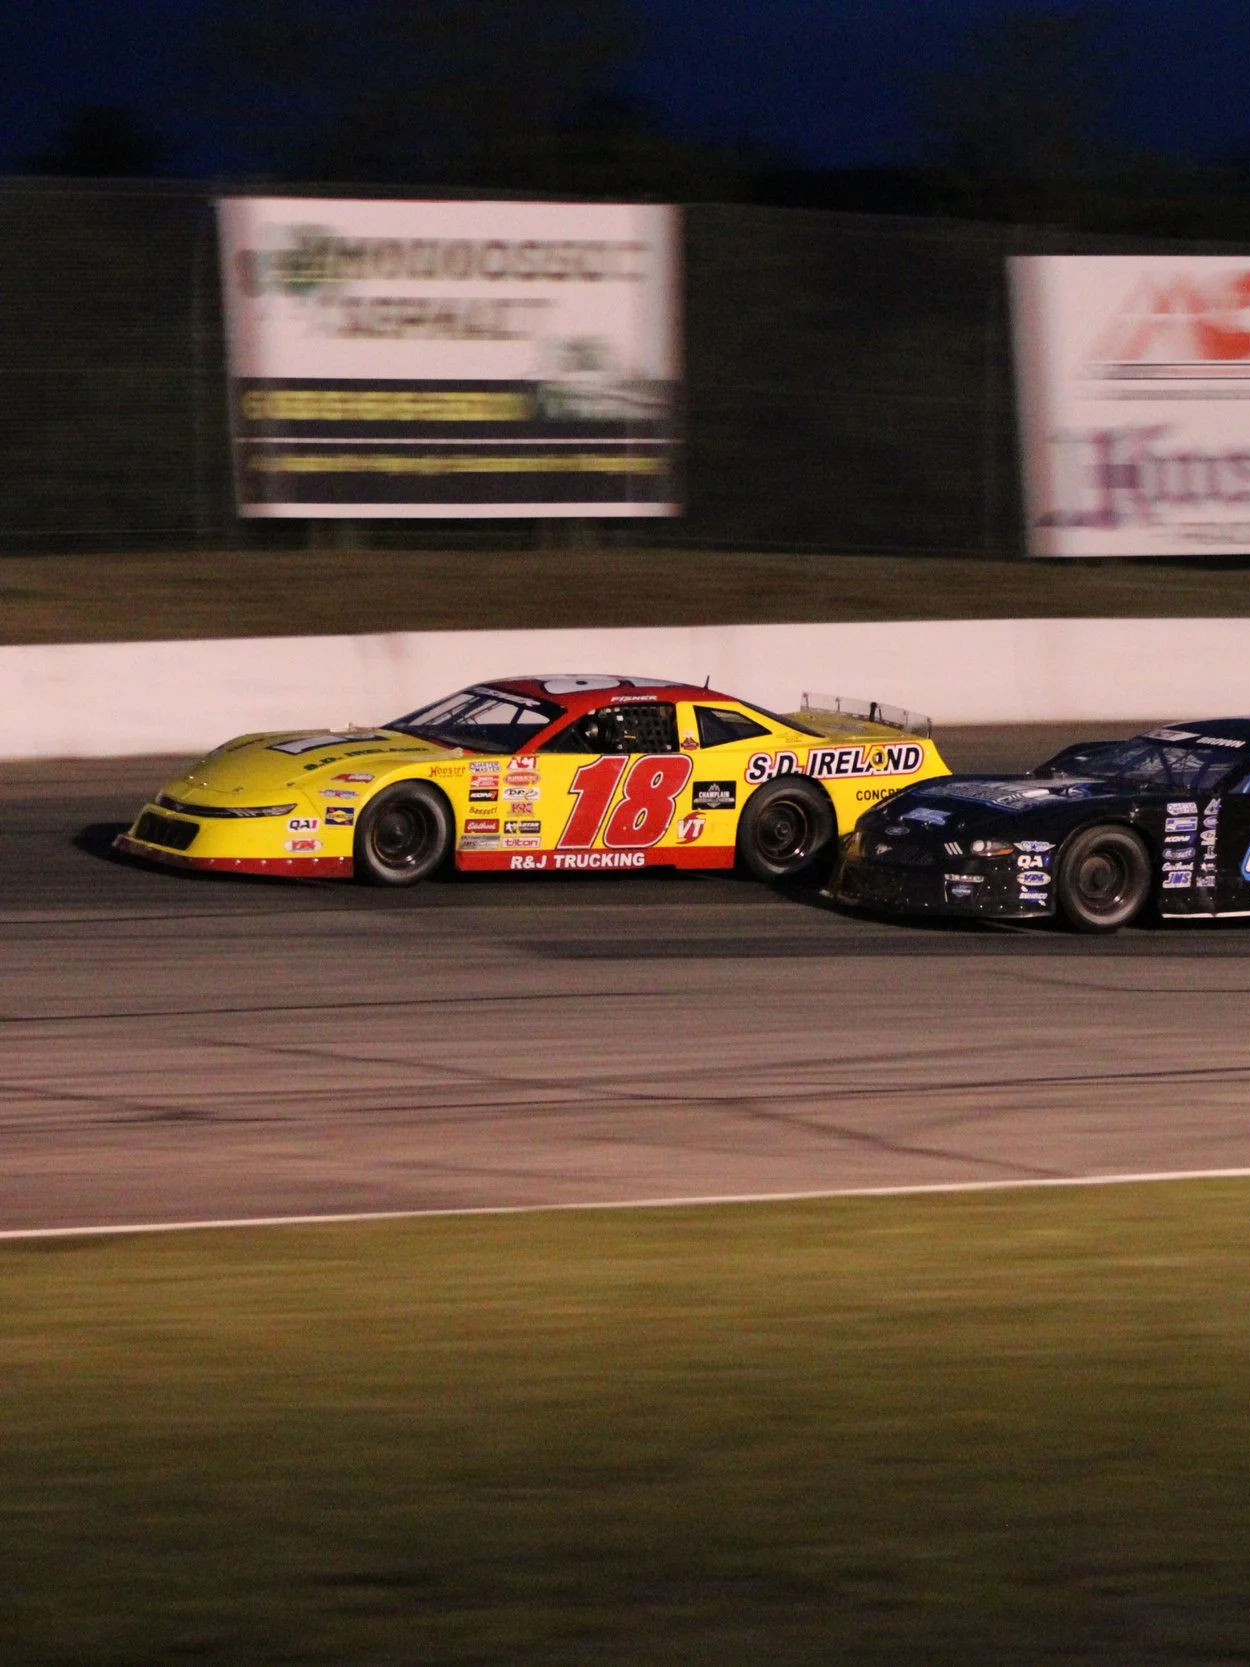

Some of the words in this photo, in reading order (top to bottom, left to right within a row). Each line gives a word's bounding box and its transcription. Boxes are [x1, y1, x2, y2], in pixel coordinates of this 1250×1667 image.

[1196, 736, 1246, 748] BROWN
[557, 753, 694, 849] 18
[677, 819, 706, 838] VT
[504, 839, 539, 847] tilton
[511, 855, 547, 869] R&J
[554, 853, 646, 868] TRUCKING
